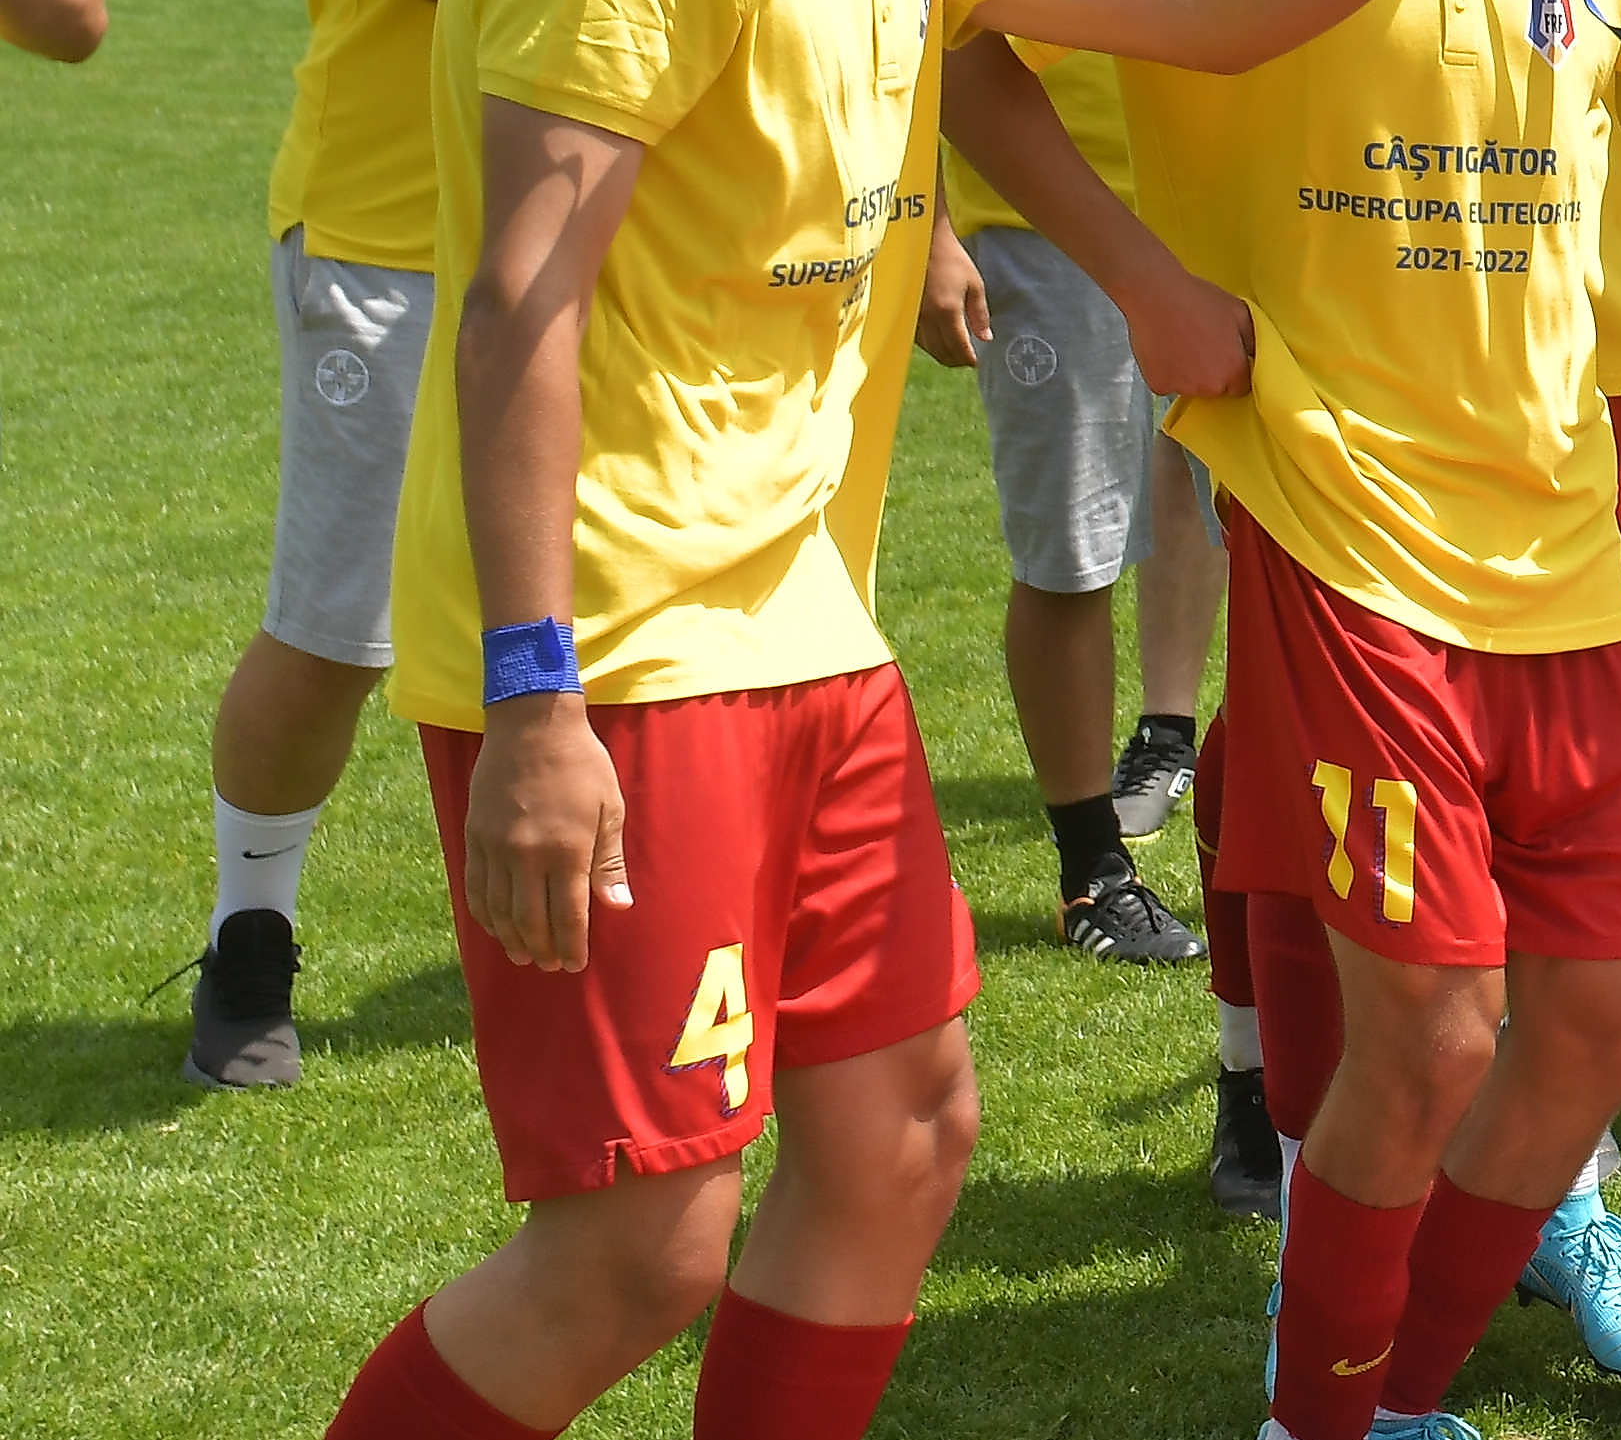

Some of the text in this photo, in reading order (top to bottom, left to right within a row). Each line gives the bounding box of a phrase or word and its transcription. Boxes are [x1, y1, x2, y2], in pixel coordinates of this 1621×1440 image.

[1543, 12, 1564, 35] FRF
[1297, 187, 1463, 224] SUPERCUPA
[1395, 245, 1529, 273] 2021-2022
[1308, 758, 1419, 924] 11
[662, 941, 755, 1118] 4
